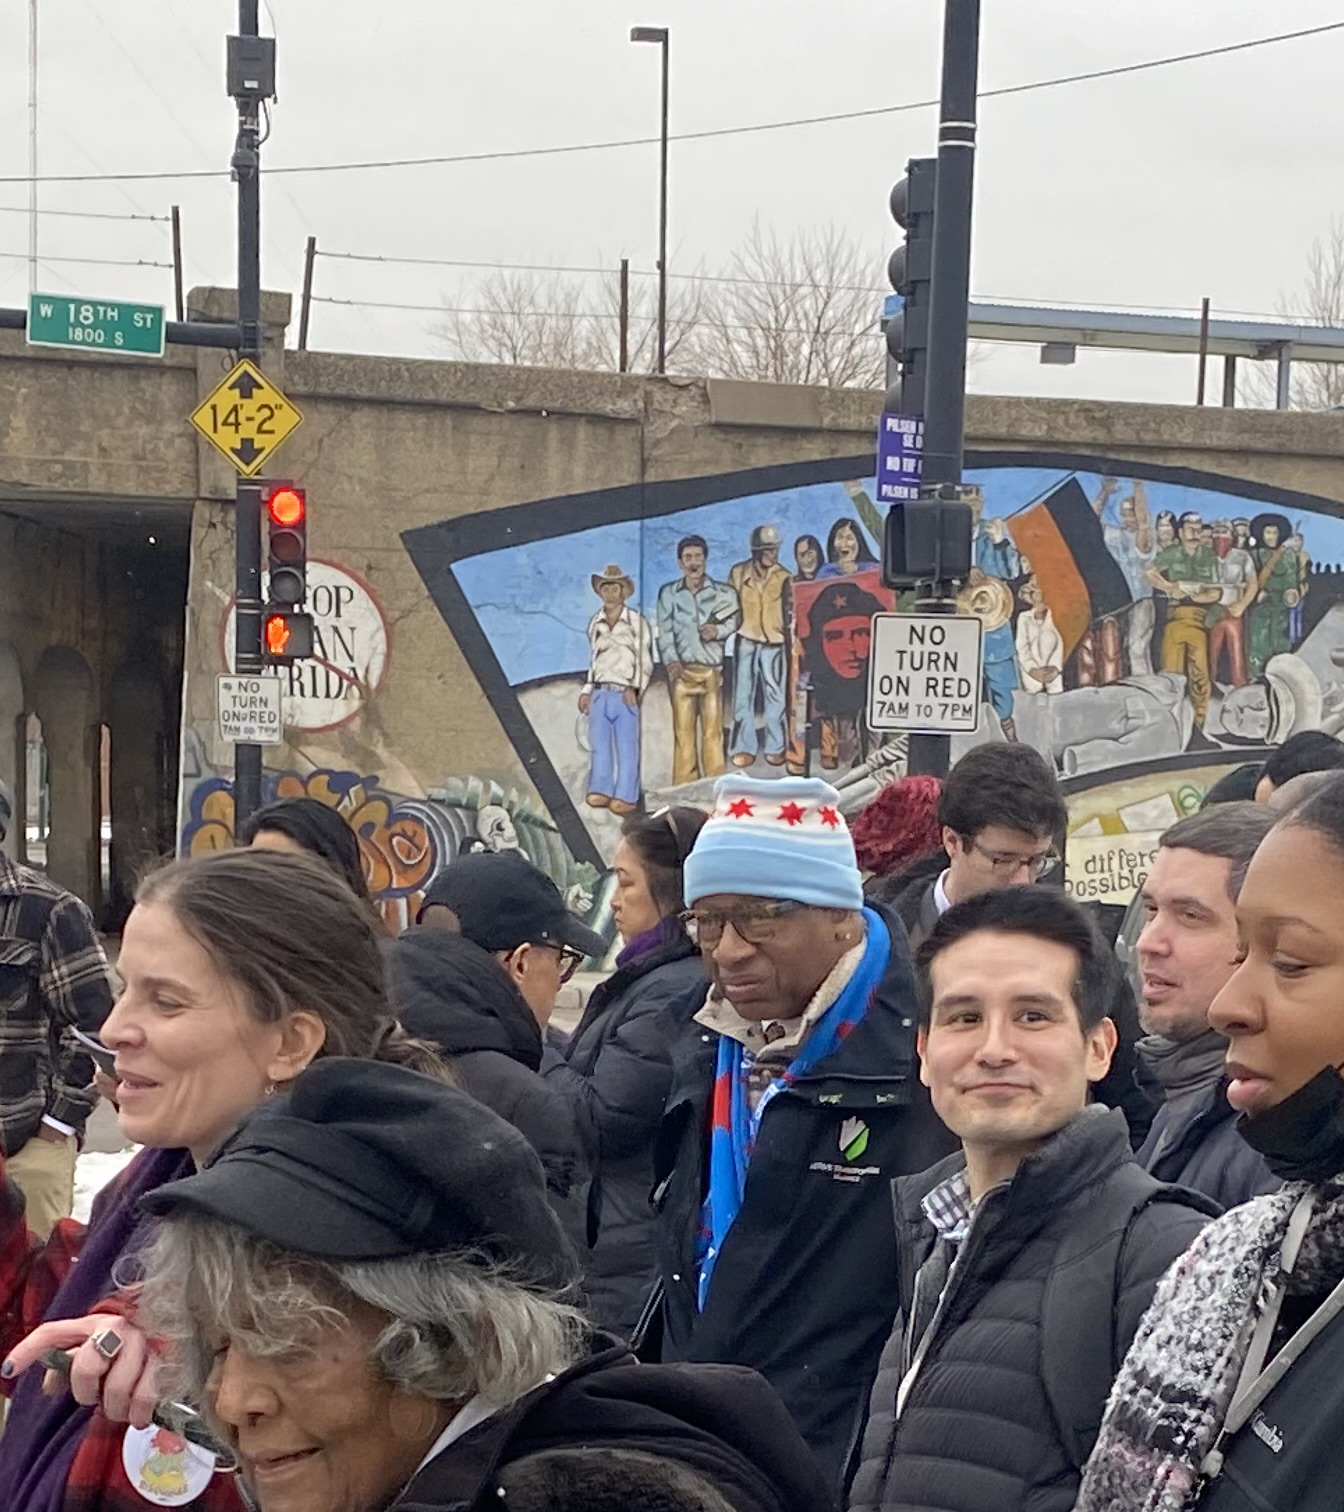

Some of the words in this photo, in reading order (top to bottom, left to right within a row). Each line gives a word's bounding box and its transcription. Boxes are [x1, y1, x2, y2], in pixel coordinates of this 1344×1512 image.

[39, 303, 54, 318] W
[67, 303, 119, 324] 18TH
[133, 311, 154, 329] ST
[67, 328, 105, 344] 1800
[113, 331, 124, 346] S
[307, 585, 354, 618] OP
[313, 625, 357, 663] AN
[908, 625, 946, 646] NO
[896, 650, 958, 673] TURN
[238, 680, 261, 694] NO
[879, 675, 910, 697] ON
[925, 677, 971, 699] RED
[231, 694, 269, 709] TURN
[877, 701, 909, 718] 7AM
[916, 703, 932, 718] TO
[938, 703, 973, 720] 7PM
[222, 709, 241, 722] ON
[249, 710, 277, 724] RED
